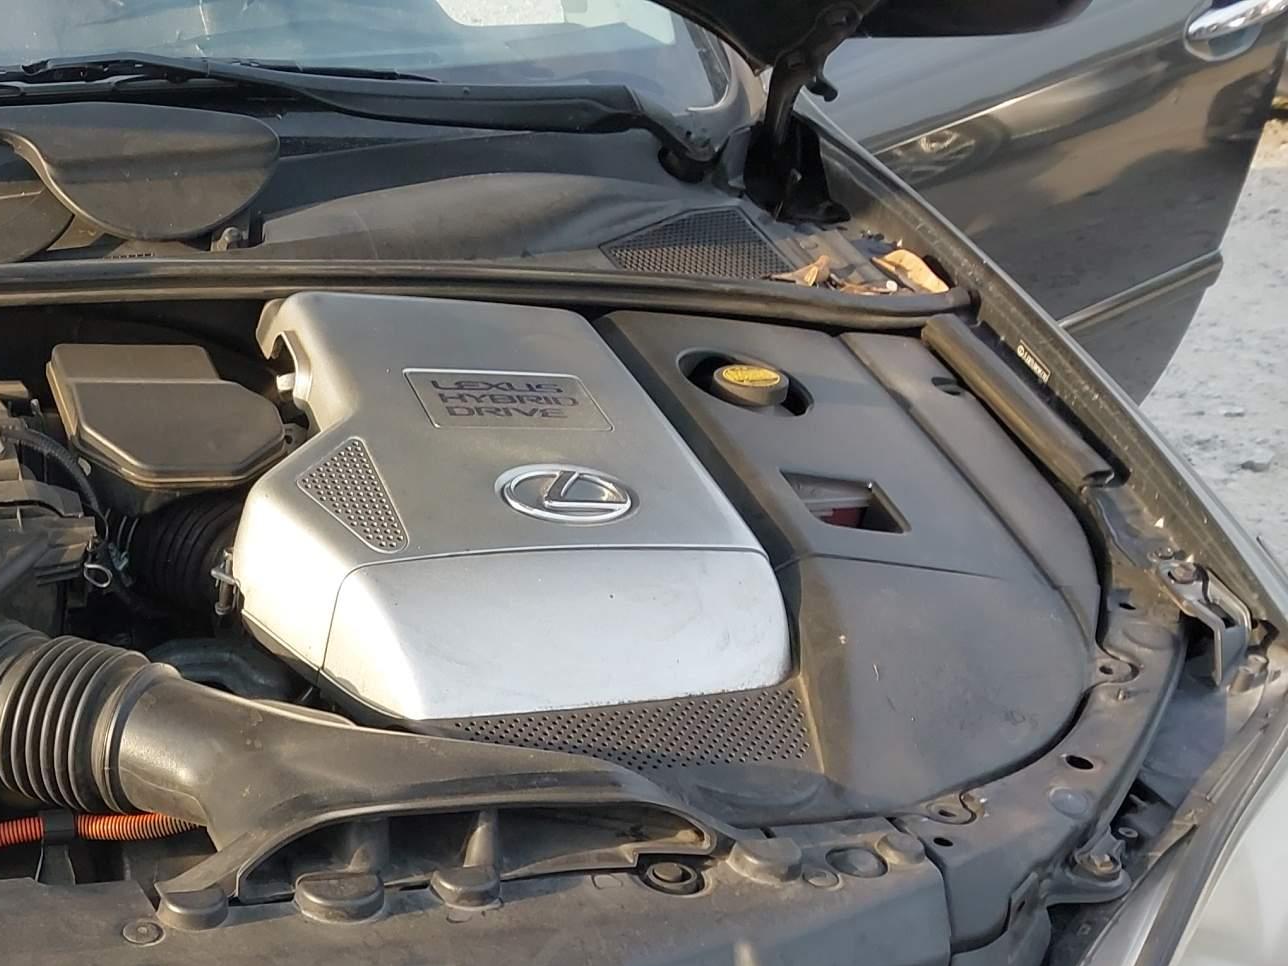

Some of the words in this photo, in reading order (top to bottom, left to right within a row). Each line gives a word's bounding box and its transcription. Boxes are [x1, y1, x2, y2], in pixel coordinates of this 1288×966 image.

[430, 380, 563, 393] LEXUS
[438, 393, 579, 407] HYBRID
[445, 406, 569, 418] DRIVE
